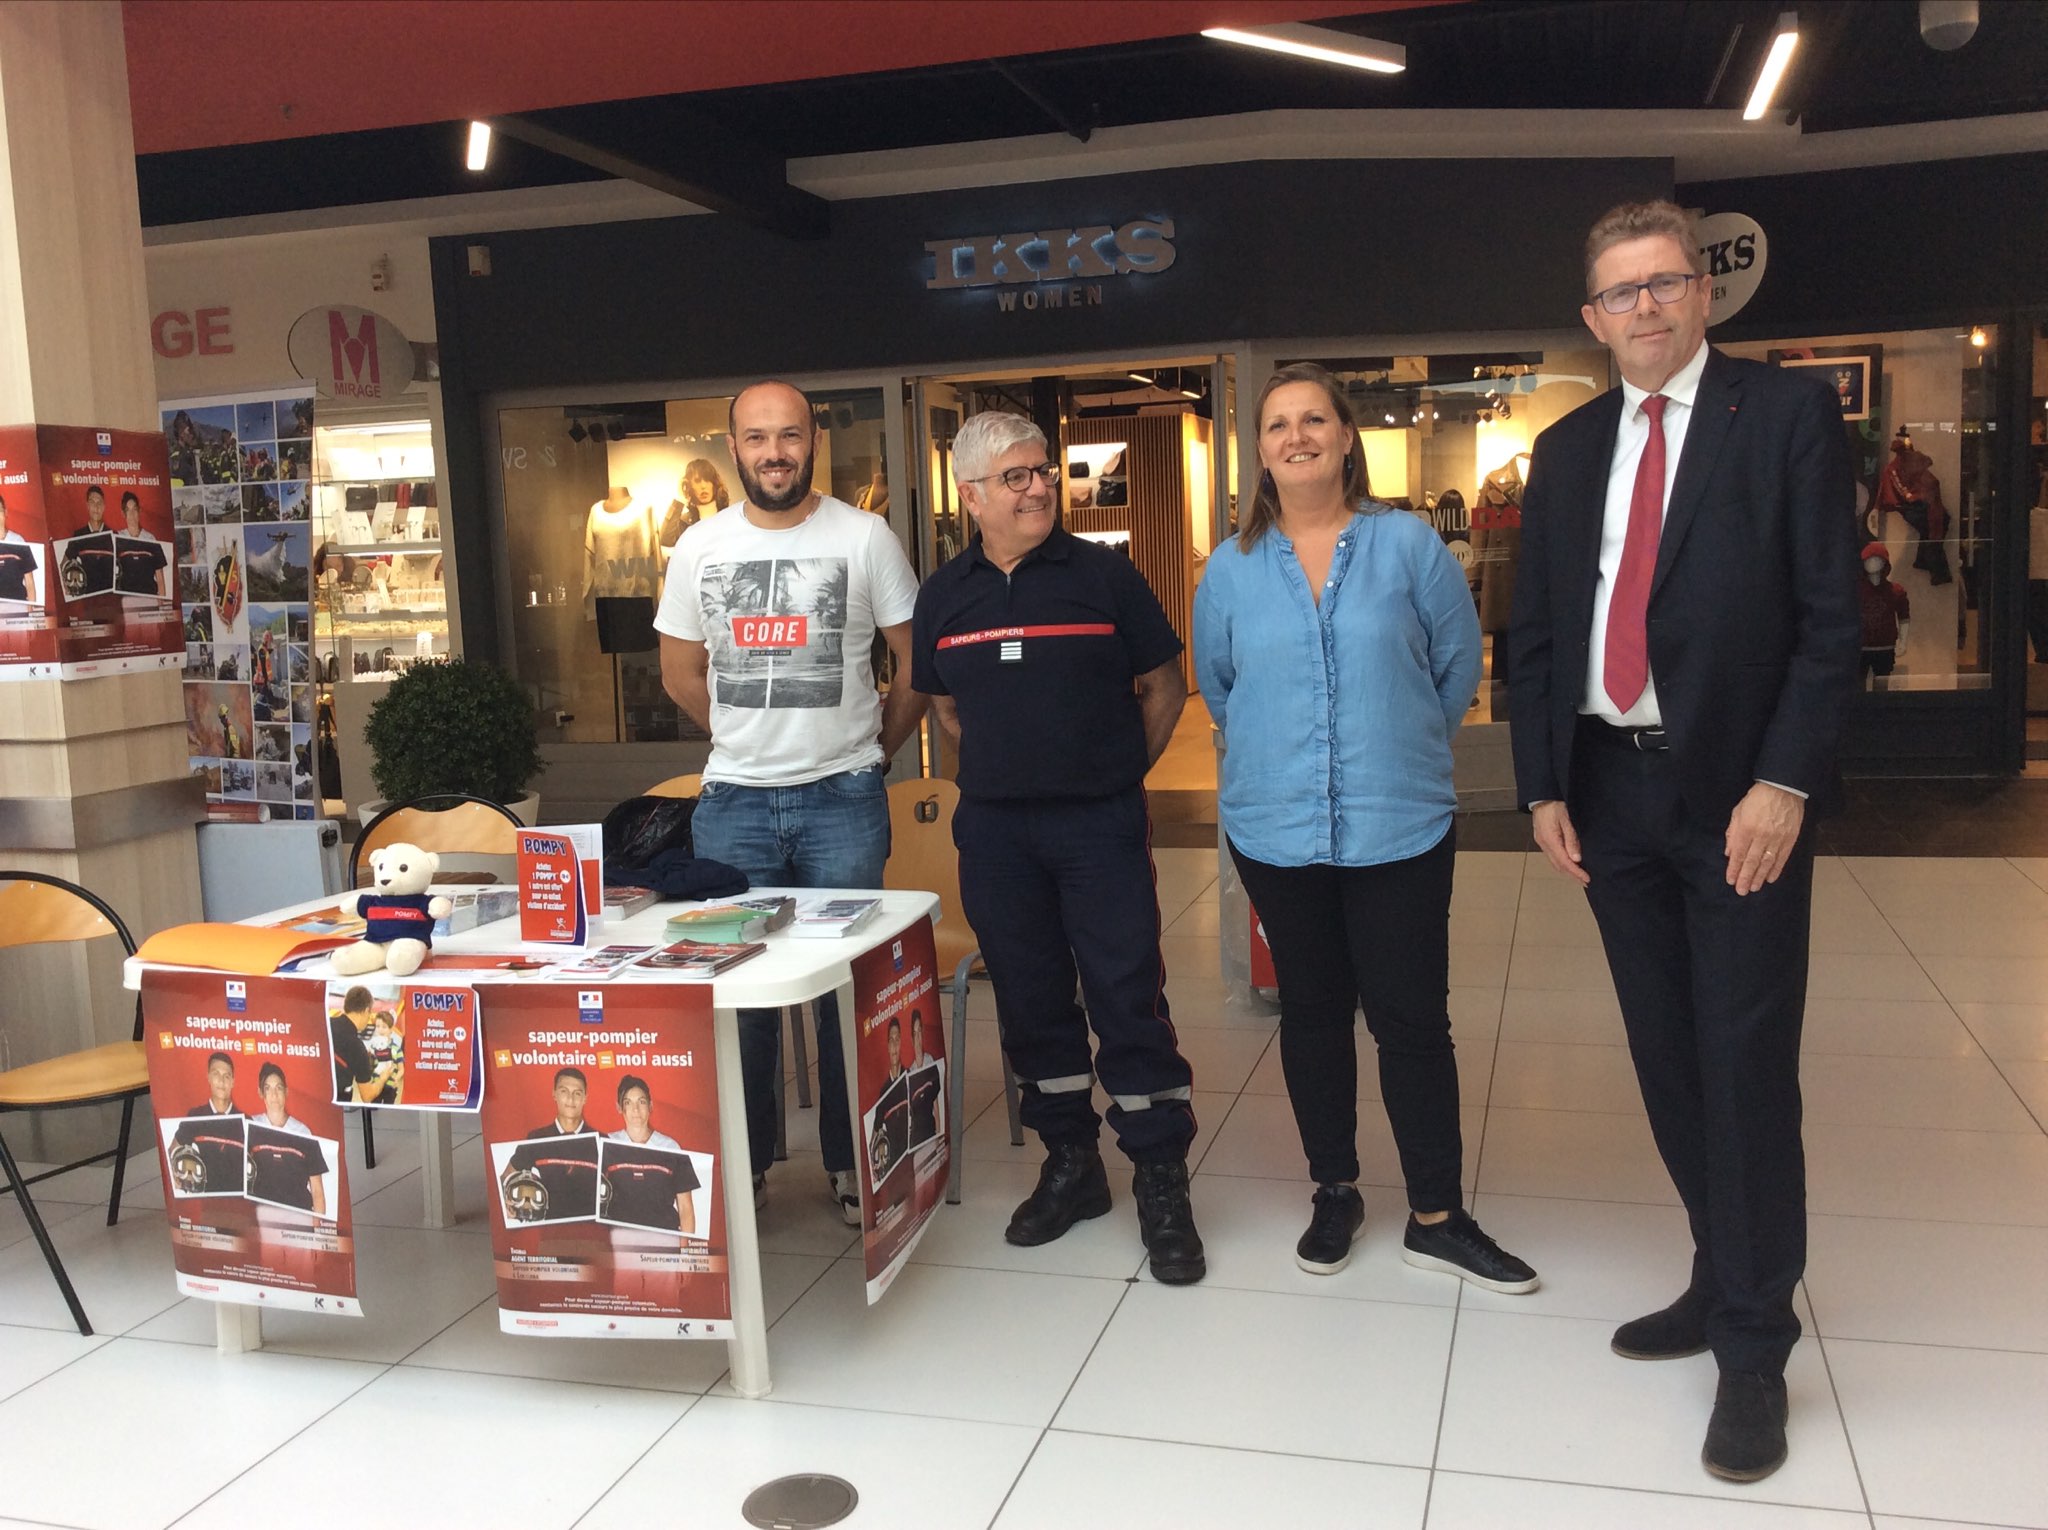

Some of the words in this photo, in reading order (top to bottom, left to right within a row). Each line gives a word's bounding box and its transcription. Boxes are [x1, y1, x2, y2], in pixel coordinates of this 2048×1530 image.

[924, 218, 1177, 289] IKKS
[1700, 232, 1755, 276] KS
[998, 285, 1102, 312] WOMEN
[334, 382, 382, 399] MIRAGE
[71, 459, 141, 472] sapeur-pompier
[4, 471, 28, 484] aussi
[62, 473, 109, 485] volontaire
[119, 475, 137, 486] moi
[138, 475, 160, 486] aussi
[1432, 508, 1470, 532] WILD
[743, 621, 799, 643] CORE
[524, 838, 567, 856] POMPY
[394, 911, 418, 919] POMPY
[413, 991, 465, 1011] POMPY
[186, 1016, 291, 1036] sapeur-pompier
[174, 1033, 242, 1051] volontaire
[257, 1040, 283, 1055] moi
[286, 1042, 320, 1058] aussi
[528, 1028, 658, 1047] sapeur-pompier
[513, 1050, 596, 1066] volontaire
[616, 1051, 647, 1066] moi
[651, 1051, 693, 1067] aussi
